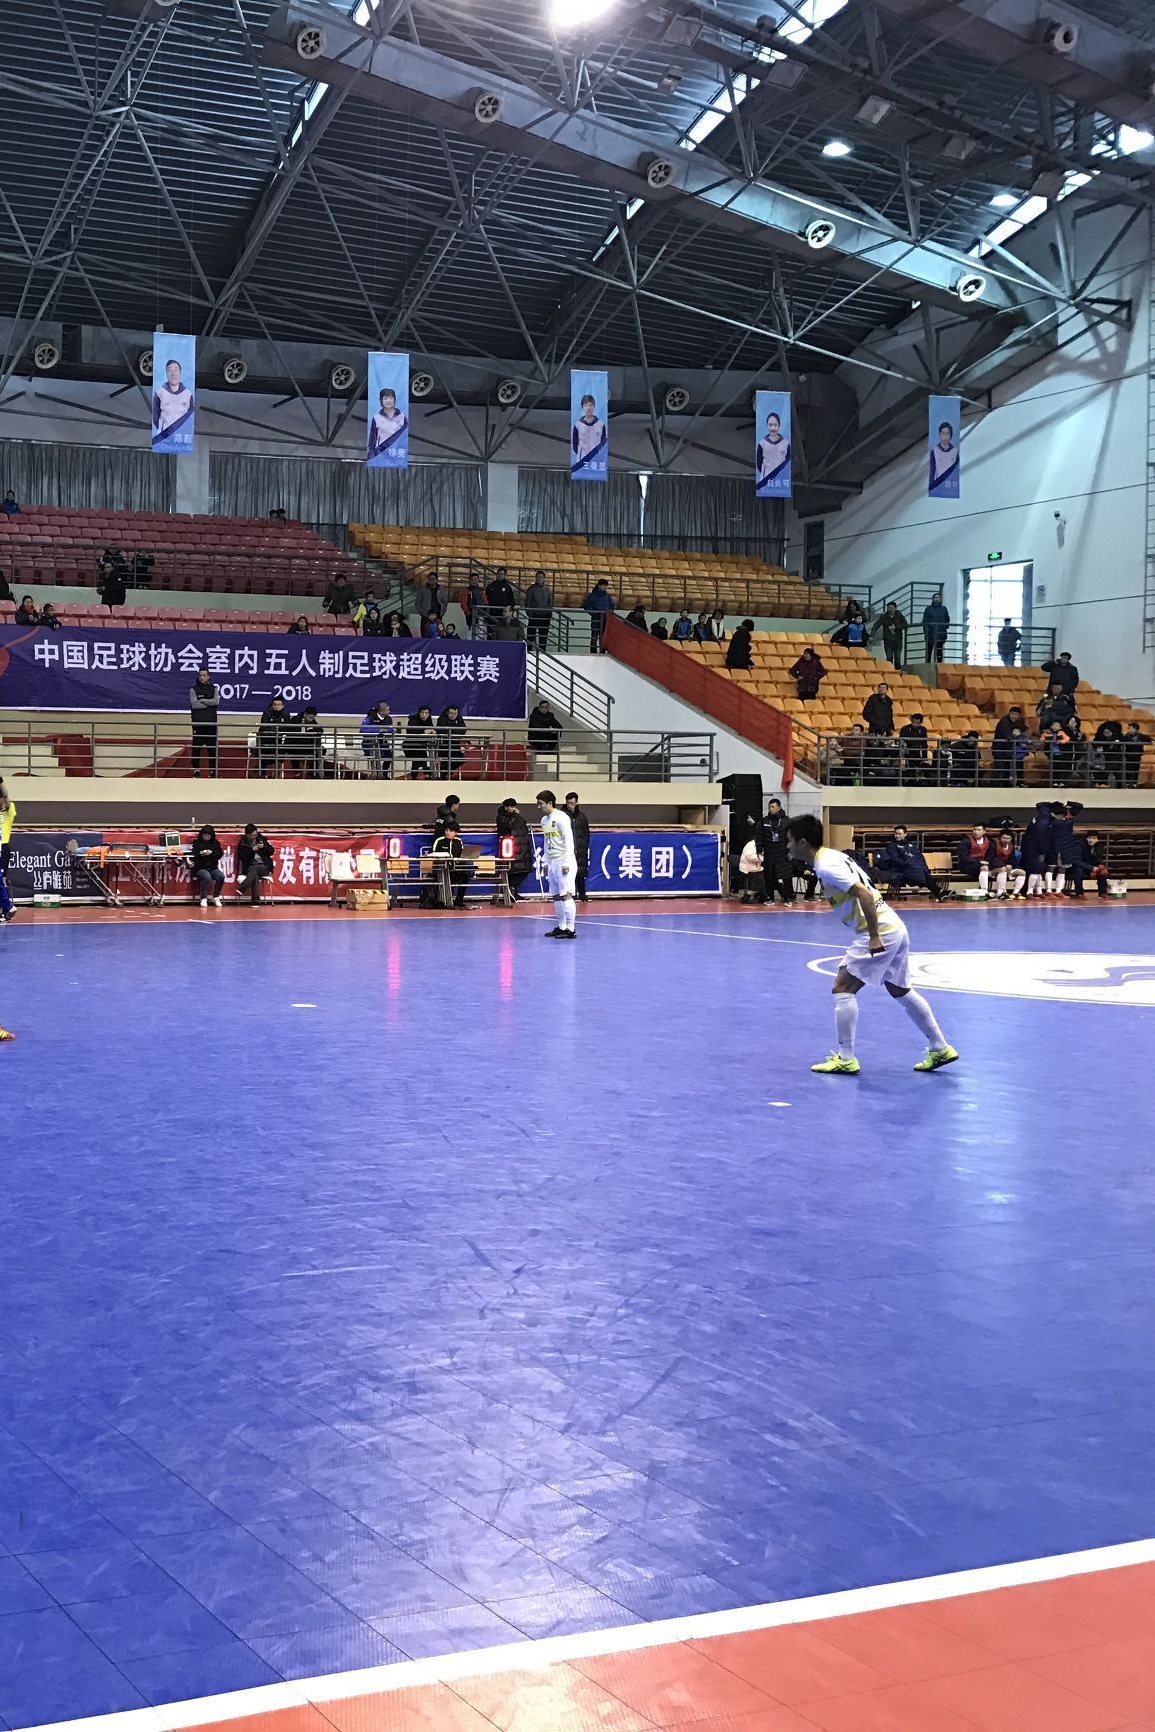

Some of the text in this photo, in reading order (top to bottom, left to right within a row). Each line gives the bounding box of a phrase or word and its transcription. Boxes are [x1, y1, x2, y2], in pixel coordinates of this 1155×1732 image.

[34, 639, 500, 683] 中国足球协会室内五人制足球超级联赛
[389, 837, 401, 858] 0
[502, 838, 513, 858] 0
[8, 850, 51, 872] Elegant
